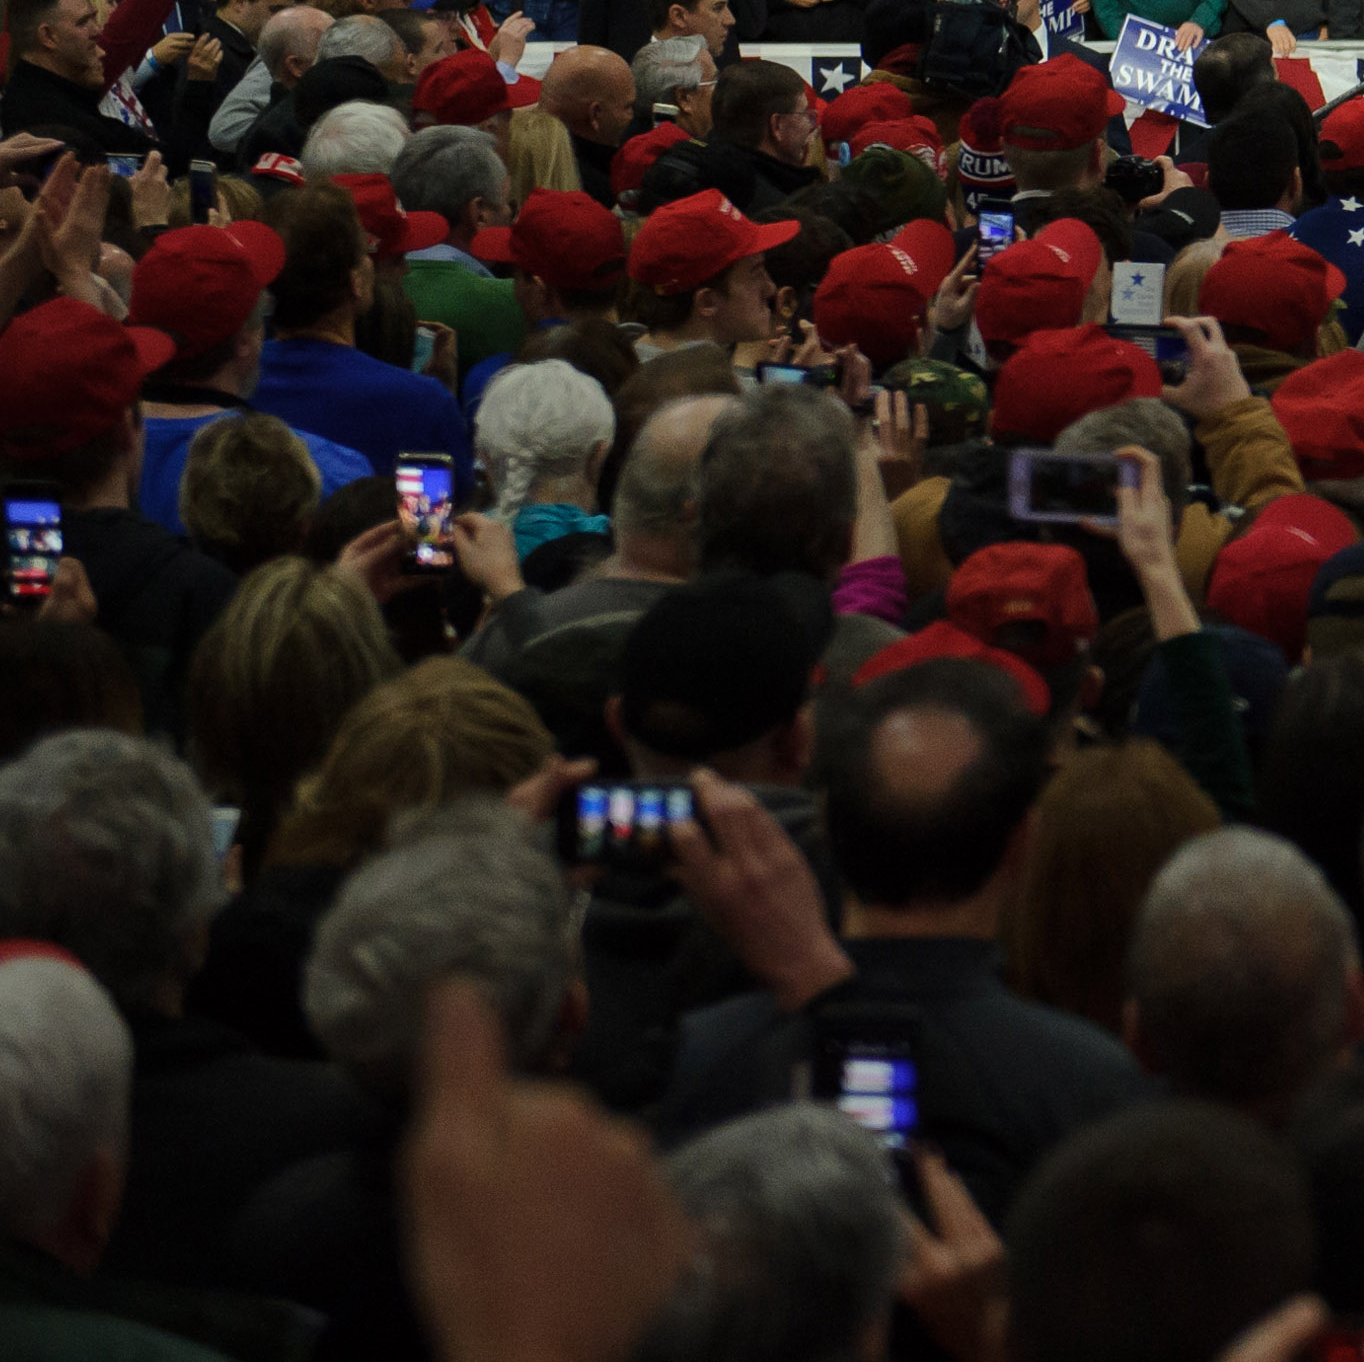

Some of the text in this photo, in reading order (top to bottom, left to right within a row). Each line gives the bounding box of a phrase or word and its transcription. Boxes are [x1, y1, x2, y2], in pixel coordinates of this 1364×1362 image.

[1136, 28, 1193, 65] DRA
[1160, 59, 1193, 82] THE
[1116, 65, 1202, 111] SWAM
[960, 147, 1011, 176] RUM
